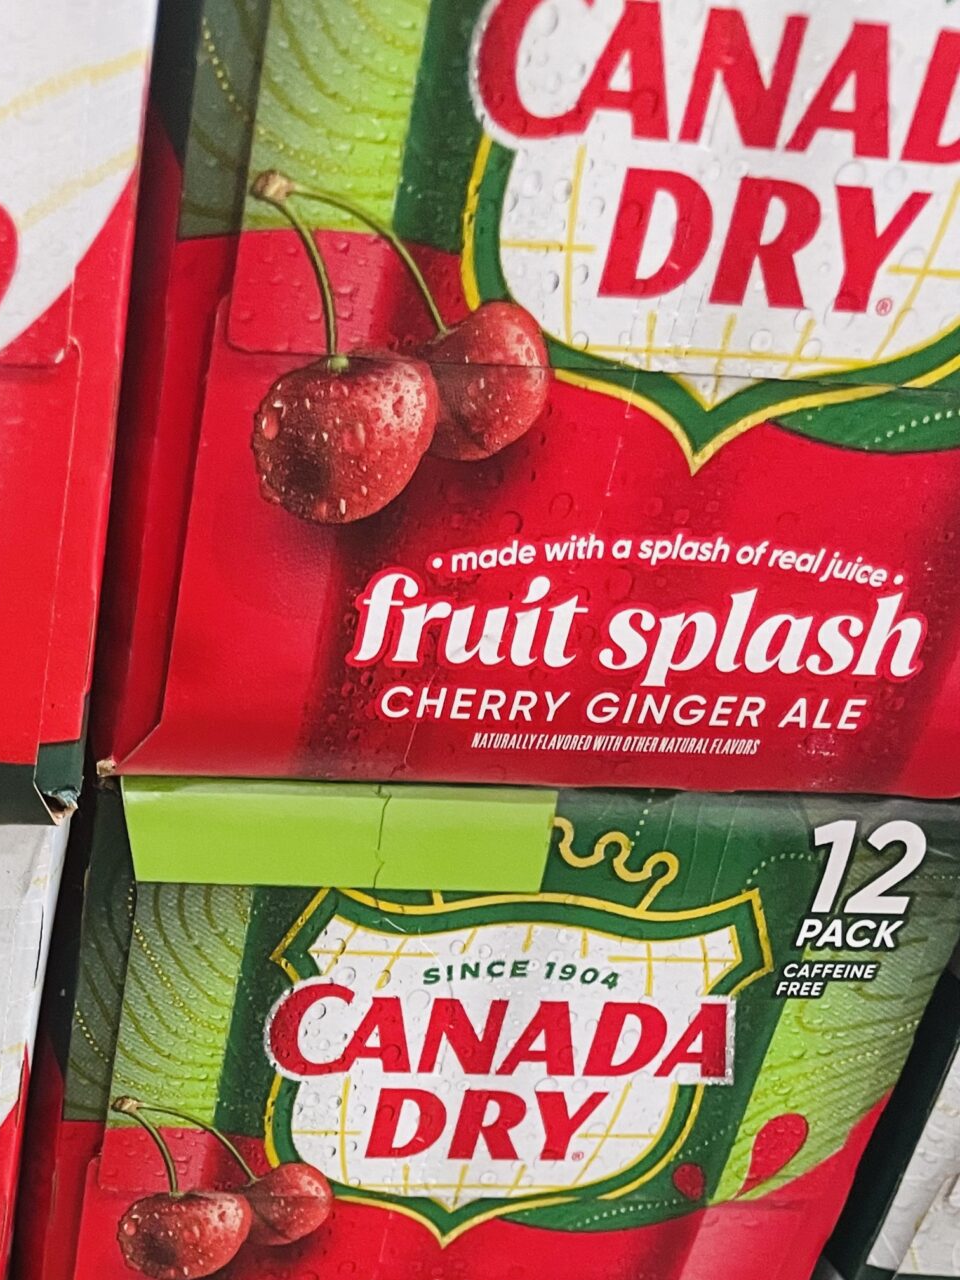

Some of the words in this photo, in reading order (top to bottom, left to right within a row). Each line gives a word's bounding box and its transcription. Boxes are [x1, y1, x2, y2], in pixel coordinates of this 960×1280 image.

[597, 168, 931, 313] DRY
[450, 536, 536, 573] made
[543, 535, 602, 562] with
[612, 541, 631, 560] a
[638, 534, 726, 565] splash
[735, 540, 768, 564] of
[768, 548, 823, 576] real
[822, 554, 888, 588] juice
[353, 573, 588, 668] fruit
[598, 588, 925, 688] splash
[381, 685, 571, 723] CHERRY
[586, 692, 764, 728] GINGER
[779, 698, 867, 730] ALE
[471, 732, 537, 750] NATURALLY
[536, 734, 592, 751] FLAVORED
[592, 735, 622, 752] WITH
[622, 737, 661, 753] OTHER
[659, 738, 708, 754] NATURAL
[709, 739, 760, 755] FLAVORS
[811, 819, 927, 915] 12
[795, 919, 903, 948] PACK
[423, 960, 529, 985] SINCE
[545, 960, 620, 990] 1904
[776, 981, 824, 996] FREE
[783, 963, 876, 979] CAFFEINE
[269, 983, 728, 1078] CANADA
[365, 1087, 609, 1161] DRY
